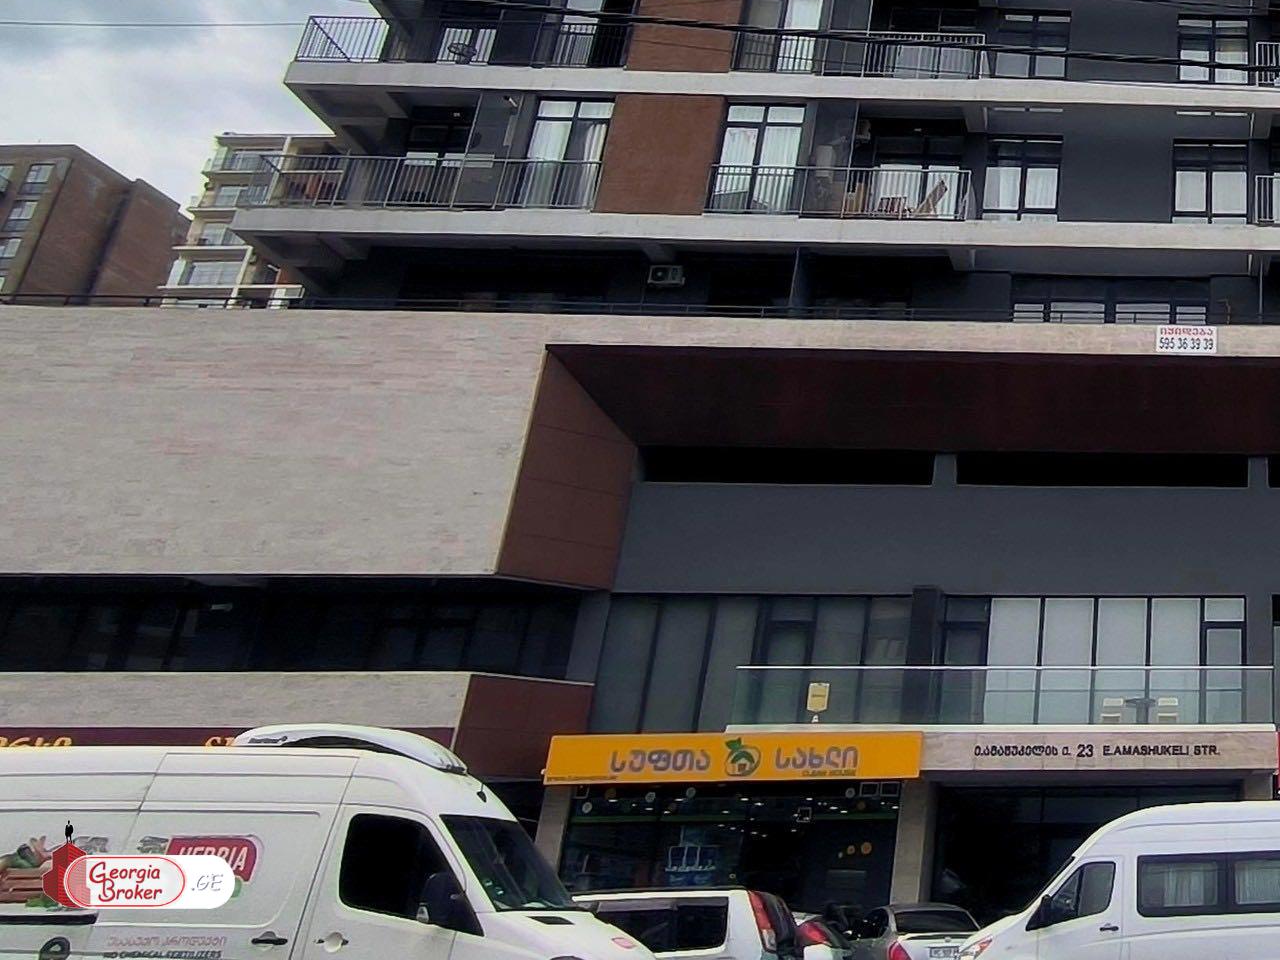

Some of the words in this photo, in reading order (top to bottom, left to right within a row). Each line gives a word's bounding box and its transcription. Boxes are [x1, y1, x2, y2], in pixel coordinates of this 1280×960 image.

[1160, 327, 1213, 336] იყიდება
[1159, 337, 1175, 349] 595
[1177, 337, 1188, 350] 36
[1190, 337, 1201, 350] 39
[1203, 338, 1214, 350] 39
[1076, 744, 1094, 758] 23
[1102, 745, 1189, 756] E.AMASHUKELI
[1193, 745, 1220, 756] STR.
[609, 748, 712, 773] სუფთა
[774, 745, 859, 770] სახლი
